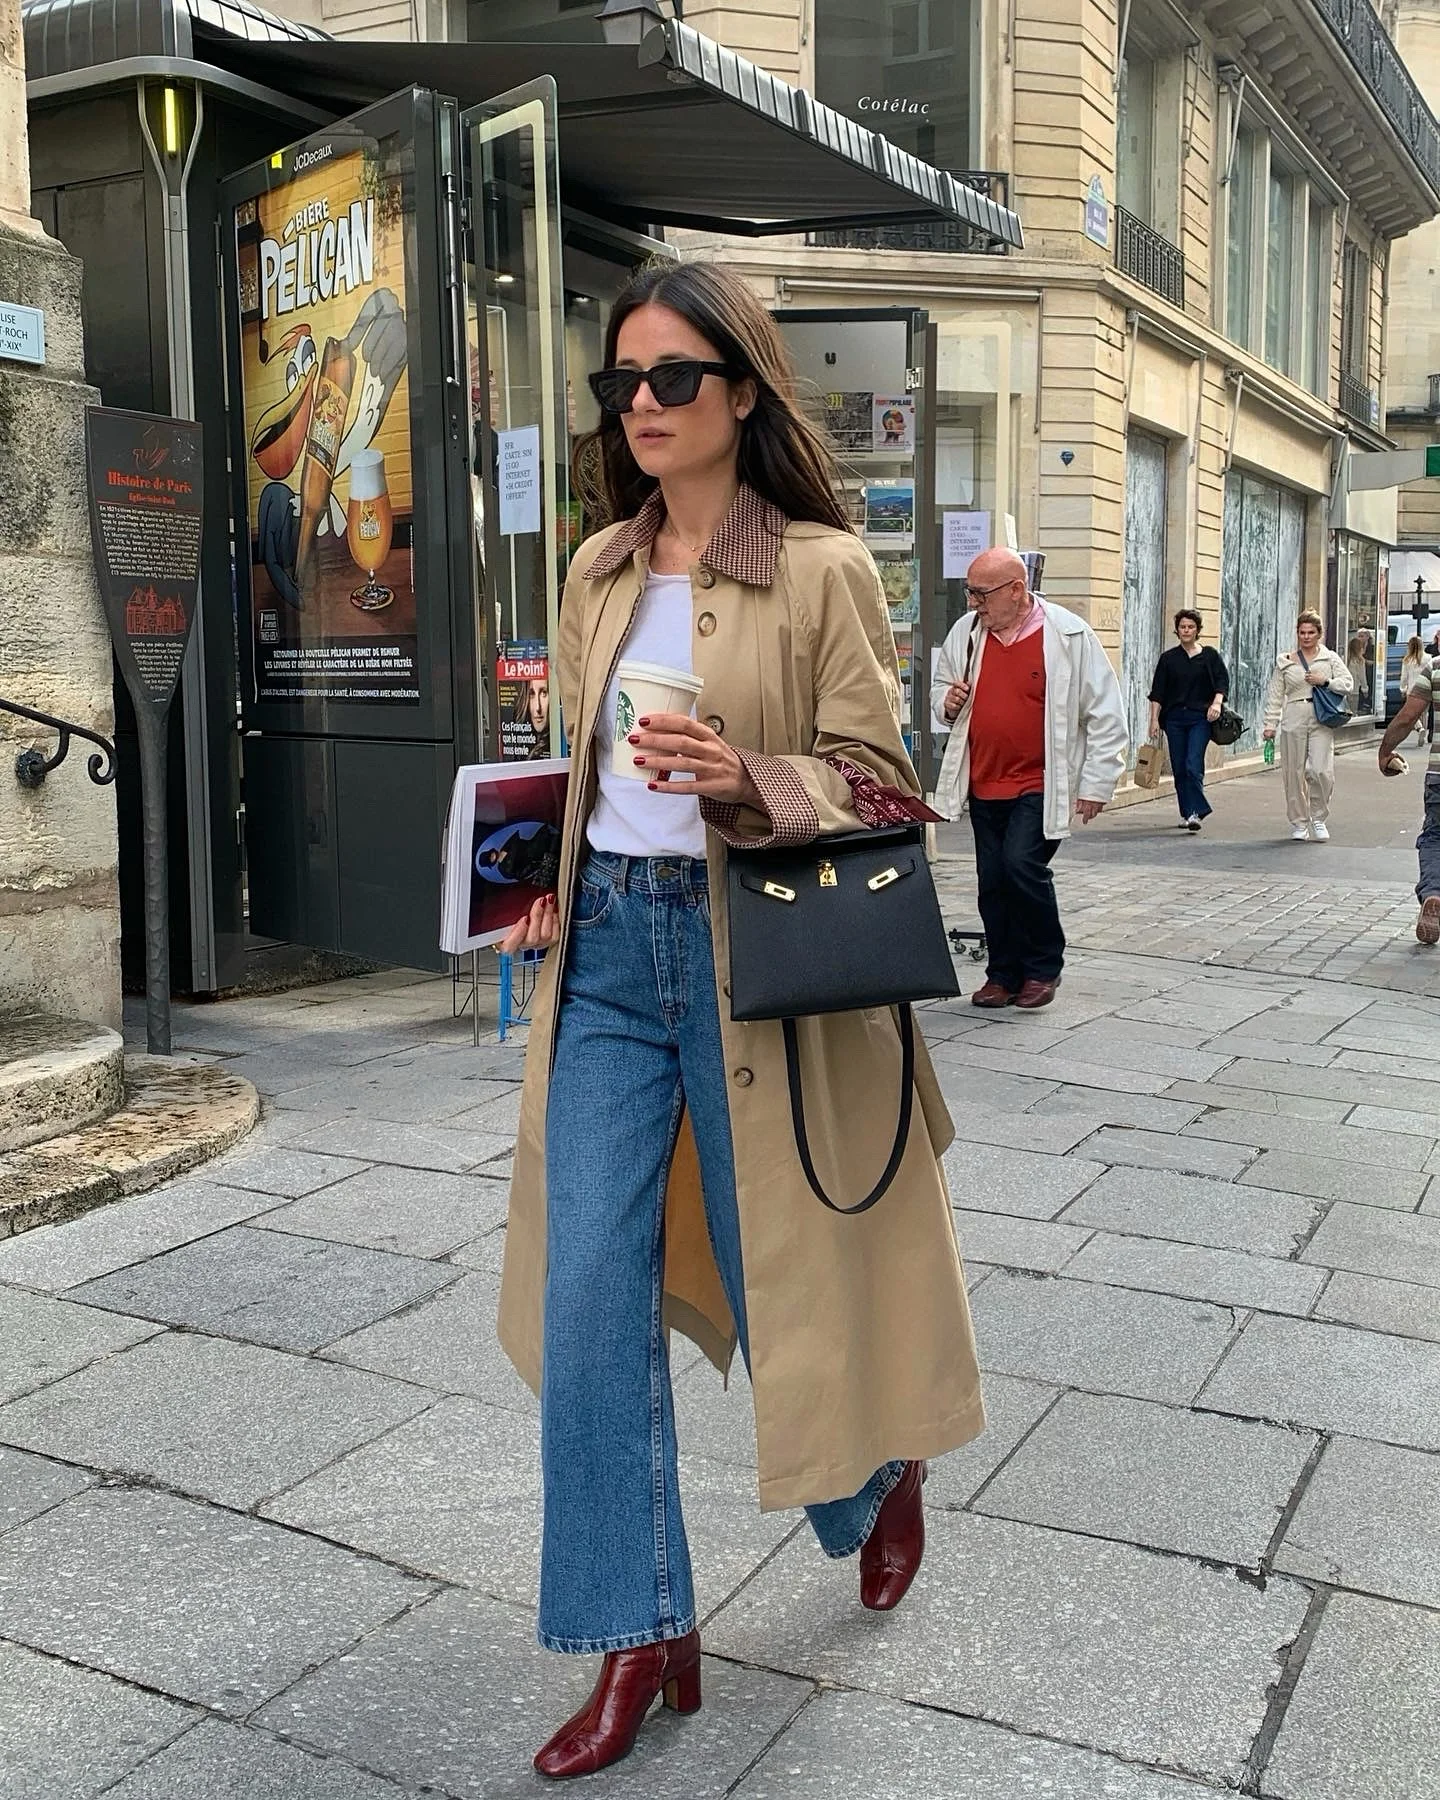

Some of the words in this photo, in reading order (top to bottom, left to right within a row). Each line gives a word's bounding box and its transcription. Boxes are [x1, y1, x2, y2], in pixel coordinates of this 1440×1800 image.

[857, 96, 929, 114] Cotélac
[293, 143, 333, 172] JCDecaux
[1, 313, 16, 324] LISE
[506, 470, 531, 480] INTERNET
[107, 470, 152, 488] Histoire
[153, 477, 164, 489] de
[167, 479, 192, 494] Paris
[504, 662, 516, 677] Le
[516, 660, 545, 677] Point
[501, 721, 510, 732] Ces
[510, 721, 532, 734] Français
[502, 735, 511, 745] que
[511, 733, 517, 743] le
[516, 733, 536, 744] monde
[514, 745, 529, 756] envie
